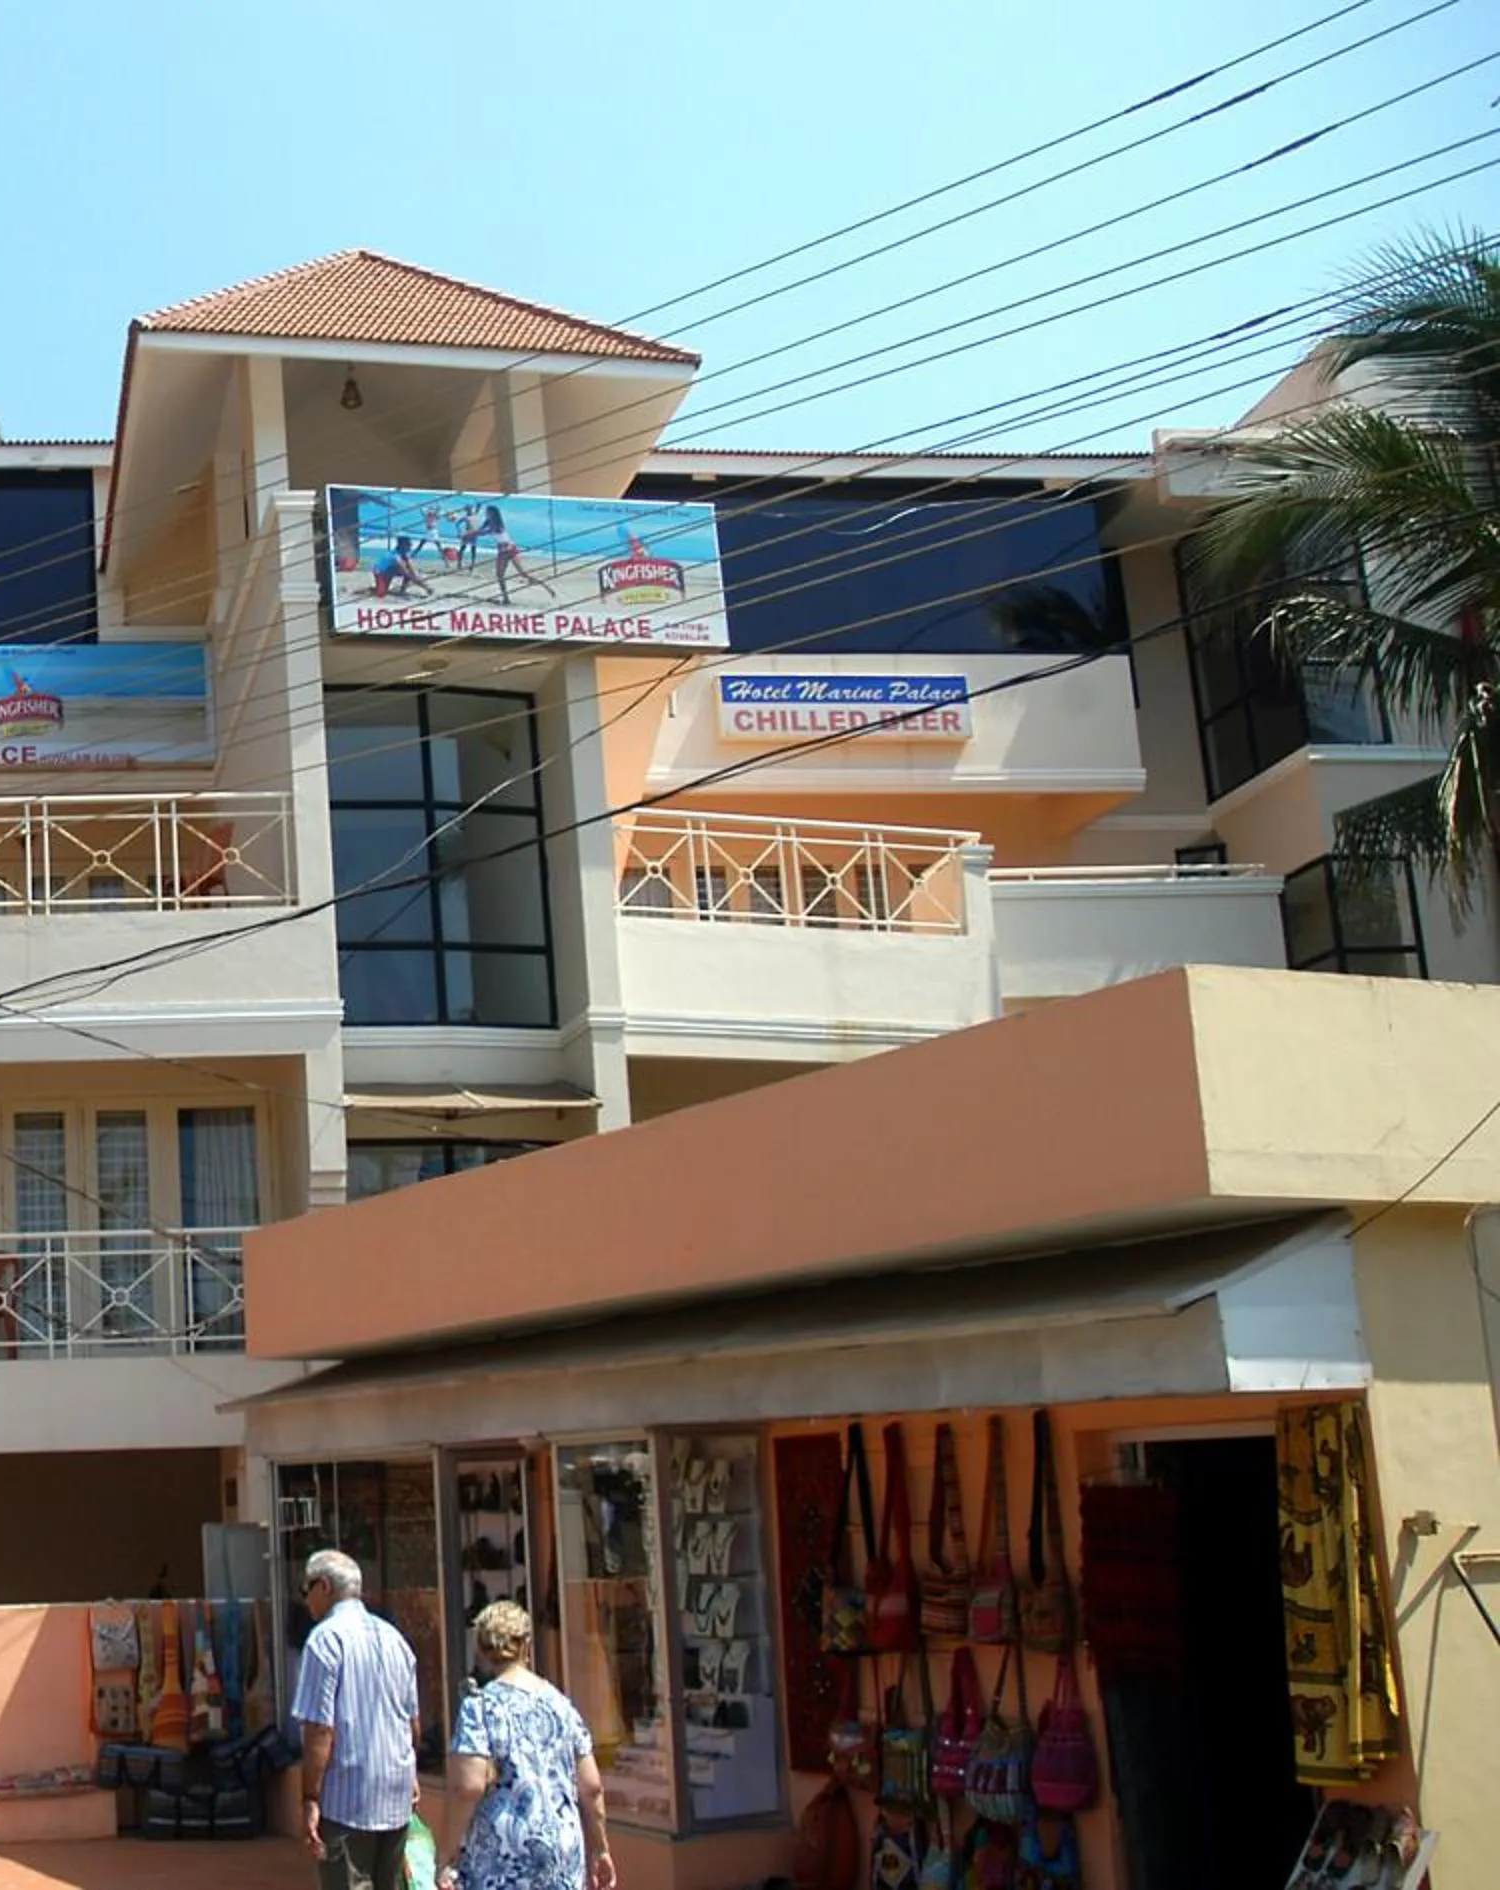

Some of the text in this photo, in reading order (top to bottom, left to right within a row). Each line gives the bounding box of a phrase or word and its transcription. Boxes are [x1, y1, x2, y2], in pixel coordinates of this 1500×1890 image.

[602, 563, 681, 590] KINGFISHER
[356, 607, 653, 639] HOTEL MARINE PALACE
[727, 680, 963, 701] Hotel Marine Palace
[733, 709, 962, 732] CHILLED BEER
